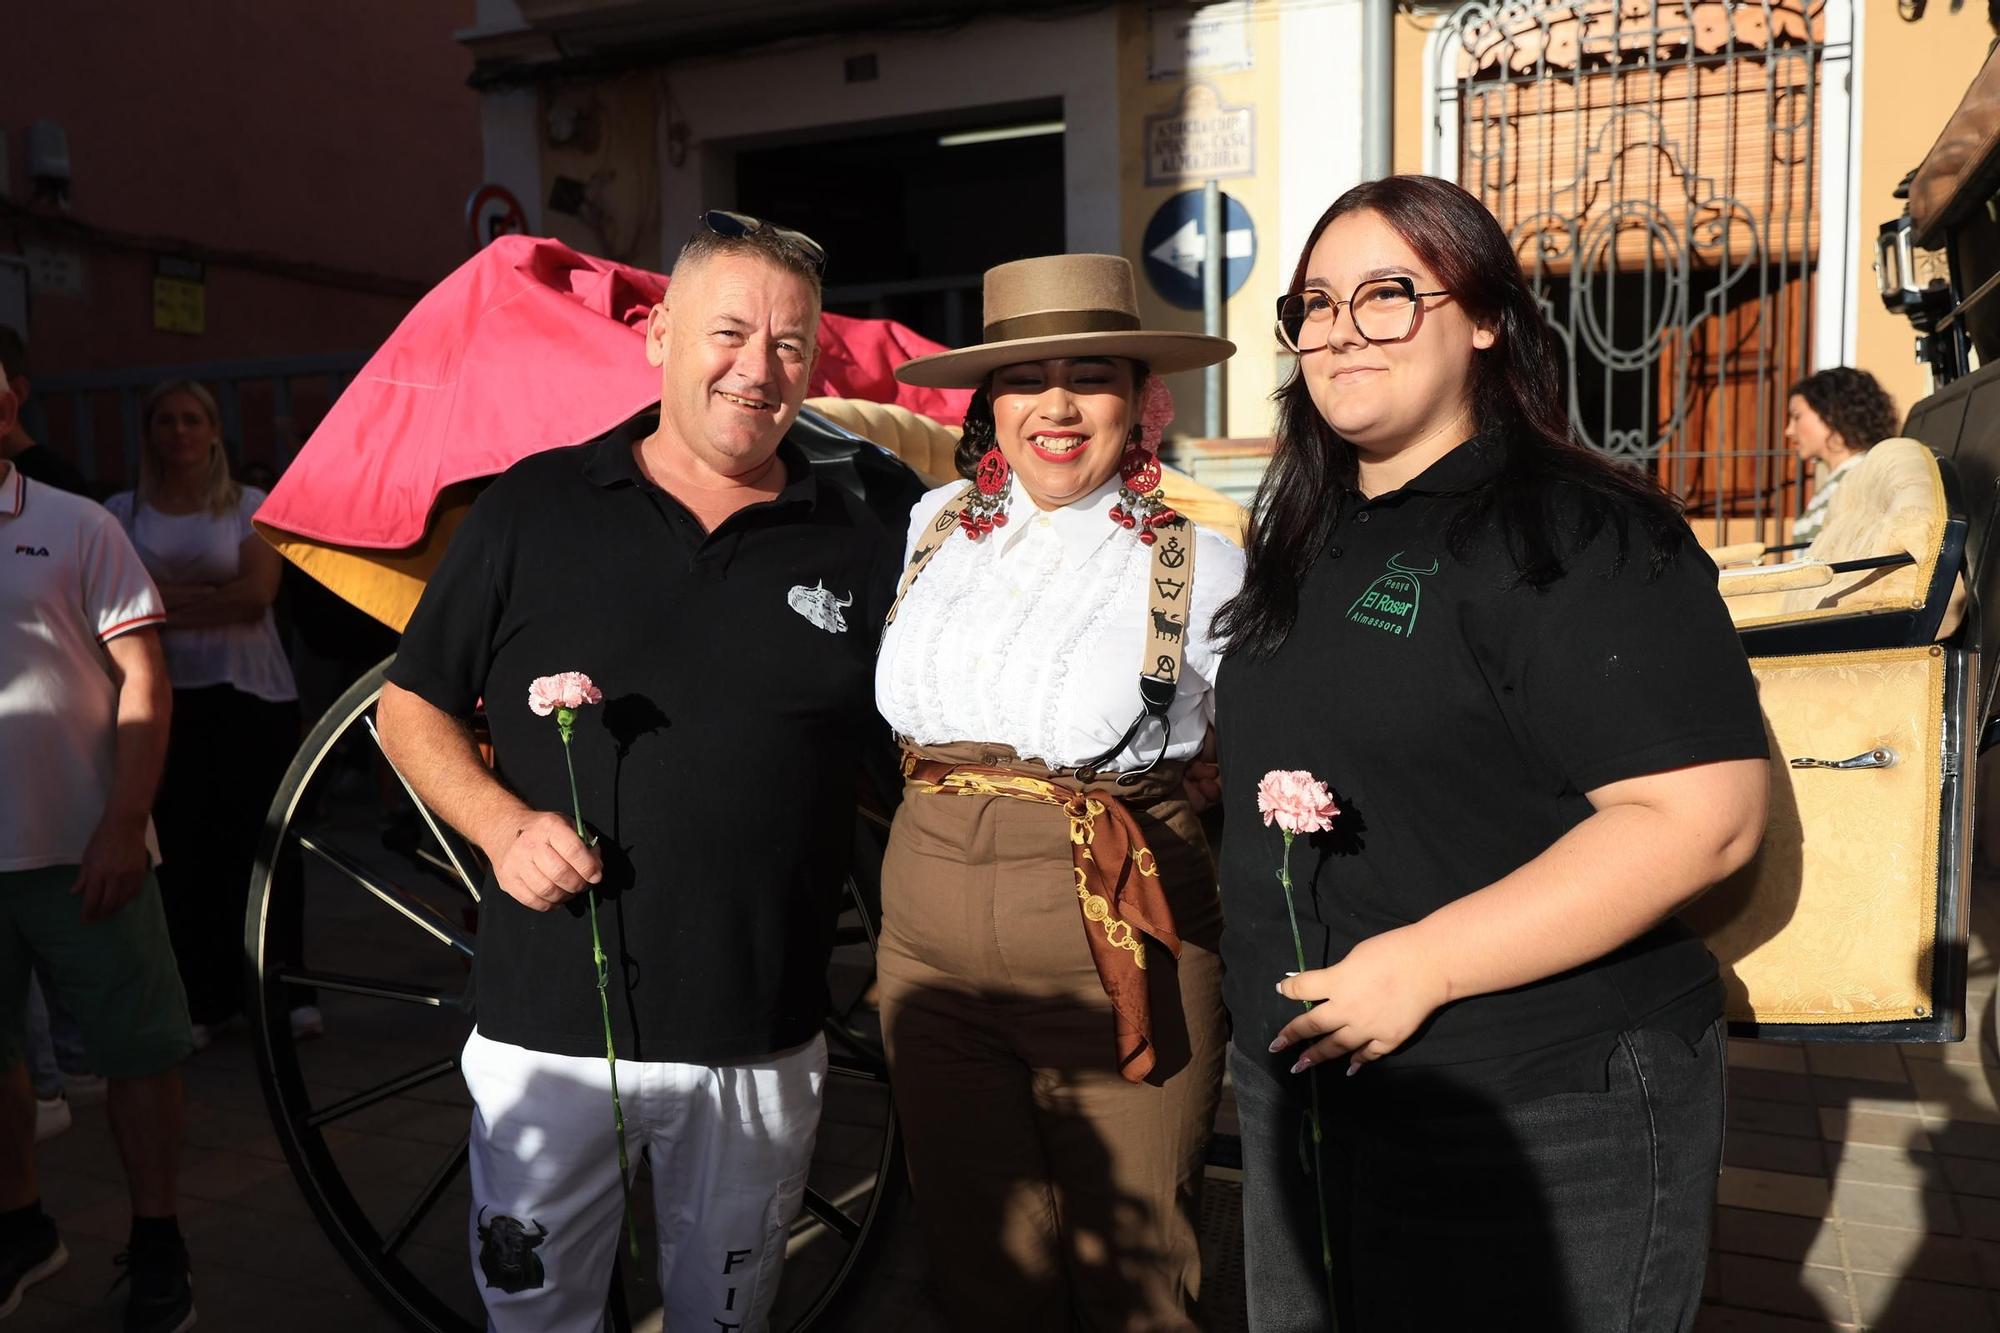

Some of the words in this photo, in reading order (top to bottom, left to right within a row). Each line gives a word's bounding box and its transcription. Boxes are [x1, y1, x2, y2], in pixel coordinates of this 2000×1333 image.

[15, 544, 50, 557] FILA
[1384, 579, 1409, 592] Penya
[1362, 591, 1381, 609] El
[1376, 595, 1412, 616] Roser
[1351, 611, 1402, 634] Almassora
